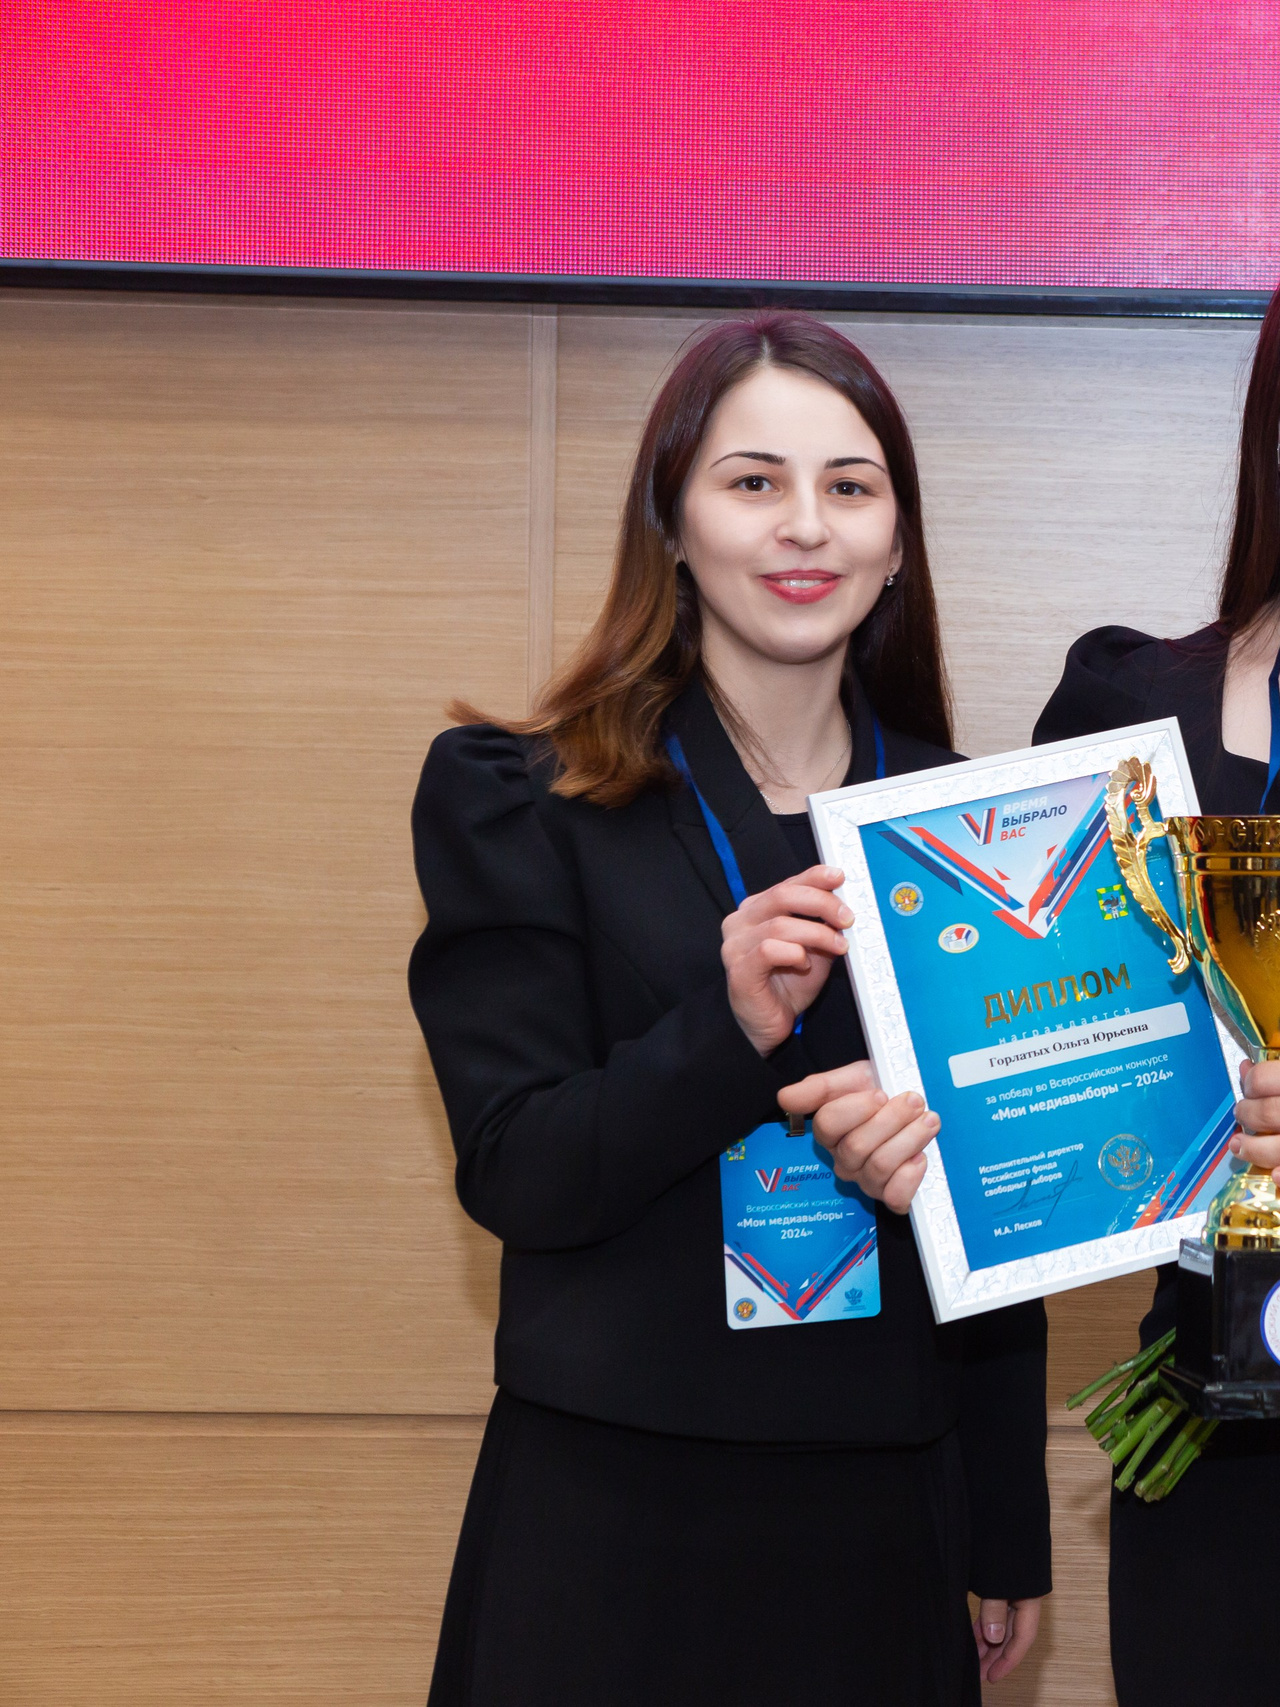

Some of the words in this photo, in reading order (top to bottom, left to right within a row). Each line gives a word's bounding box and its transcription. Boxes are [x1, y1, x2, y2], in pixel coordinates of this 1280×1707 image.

[1003, 796, 1048, 815] ВРЕМЯ
[1001, 804, 1068, 828] ВЫБРАЛО
[1000, 826, 1027, 842] ВАС
[983, 962, 1132, 1029] ДИПЛОМ
[989, 1046, 1051, 1067] Горлатых
[1052, 1037, 1090, 1053] Ольга
[1092, 1023, 1149, 1043] Юрьевна
[985, 1095, 997, 1105] за
[998, 1086, 1033, 1102] победу
[1035, 1083, 1048, 1093] во
[1049, 1065, 1124, 1090] Всероссийском
[1125, 1053, 1169, 1071] конкурсе
[991, 1106, 1027, 1121] «Мои
[1029, 1083, 1119, 1114] медиавыборы
[1134, 1069, 1174, 1088] 2024»
[979, 1151, 1046, 1174] Исполнительный
[1047, 1143, 1084, 1159] директор
[784, 1171, 832, 1183] ВЫБРАЛО
[786, 1164, 820, 1174] ВРЕМЯ
[981, 1168, 1031, 1186] Российского
[1031, 1161, 1058, 1175] фонда
[781, 1183, 801, 1192] ВАС
[746, 1199, 809, 1213] Всероссийский
[811, 1198, 845, 1208] конкурс
[737, 1217, 766, 1228] «Мои
[769, 1211, 843, 1226] медиавыборы
[993, 1226, 1013, 1237] И.А.
[1014, 1218, 1043, 1232] Лесков
[781, 1228, 813, 1240] 2024»
